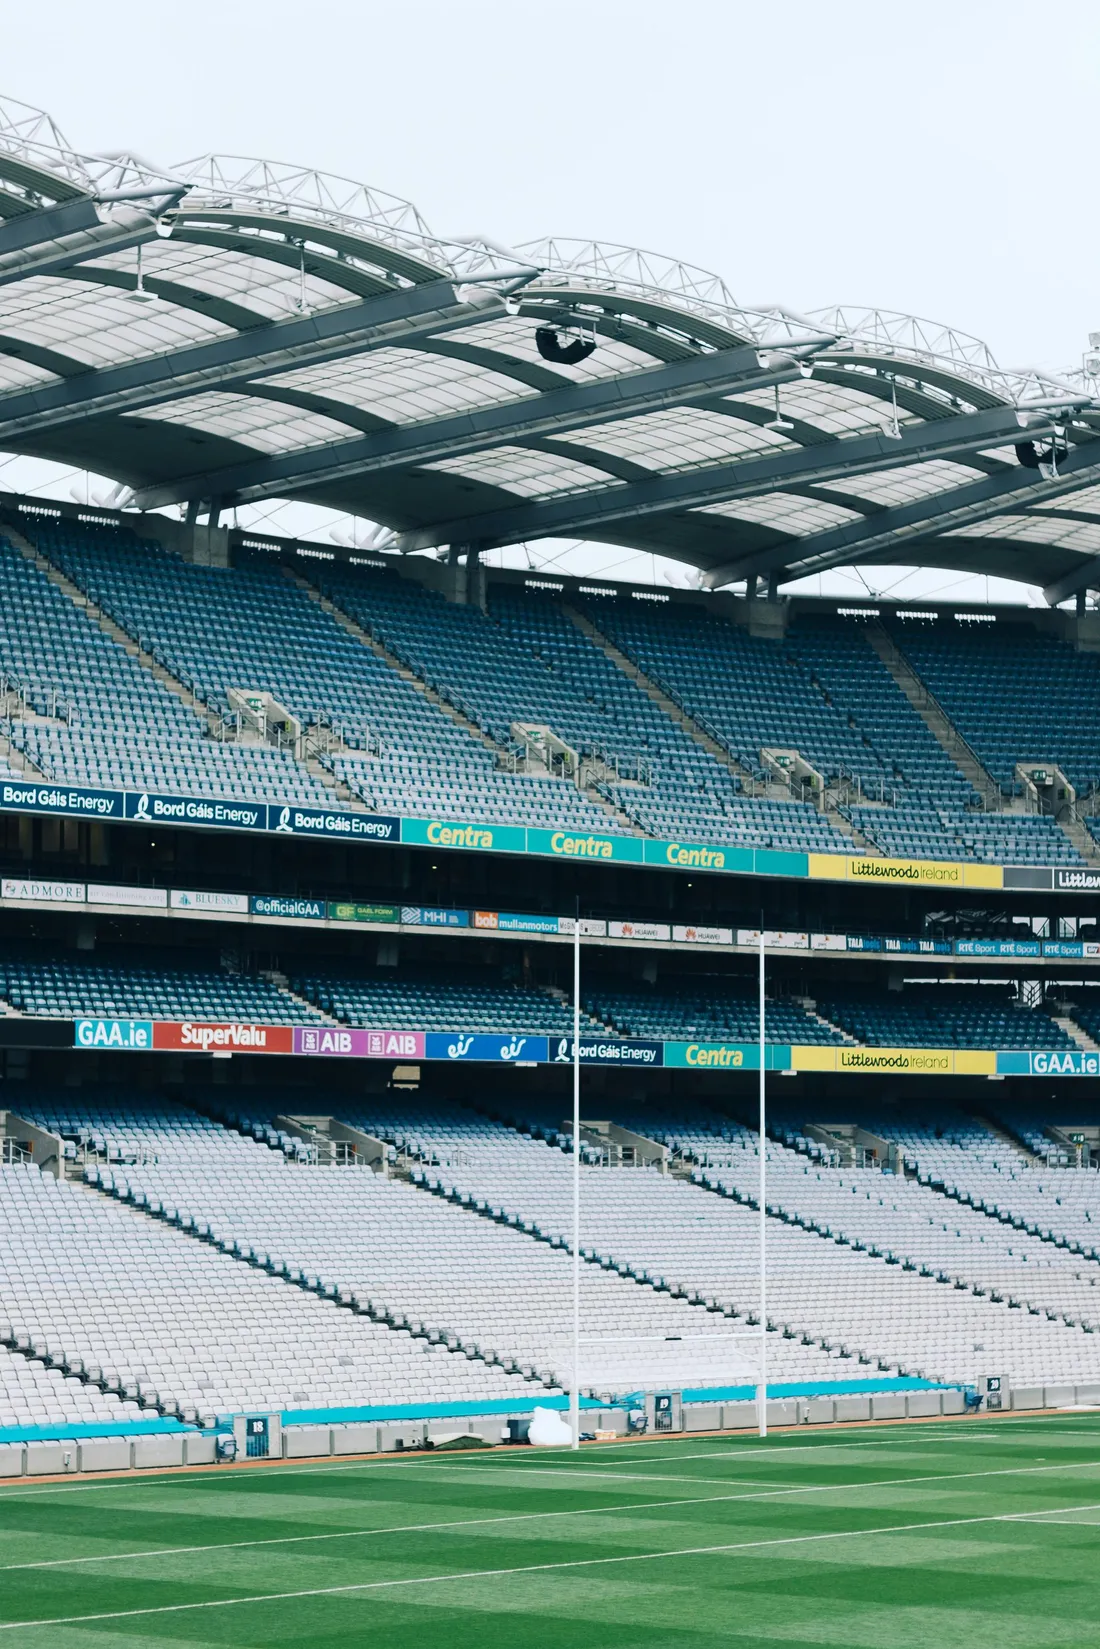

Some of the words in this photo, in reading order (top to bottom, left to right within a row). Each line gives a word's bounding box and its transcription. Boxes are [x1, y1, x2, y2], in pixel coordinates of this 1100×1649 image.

[4, 786, 36, 804] Bord
[38, 789, 67, 807] Gáis
[68, 793, 114, 813] Energy
[154, 800, 185, 816] Bord
[186, 802, 213, 820] Gáis
[215, 805, 258, 825] Energy
[295, 813, 324, 829] Bord
[325, 816, 350, 831] Gáis
[352, 819, 392, 838] Energy
[427, 822, 493, 848] Centra
[551, 832, 613, 858] Centra
[666, 843, 725, 868] Centra
[21, 884, 82, 898] ADMORE
[195, 893, 240, 906] BLUESKY
[255, 900, 320, 916] @officialGAA
[336, 905, 354, 917] GF
[424, 911, 446, 923] MHI
[475, 913, 497, 928] bob
[499, 919, 558, 932] mullanmotors
[635, 928, 658, 936] HUAWEI
[848, 937, 863, 949] TALA
[885, 939, 900, 950] TALA
[919, 940, 934, 951] TALA
[975, 944, 996, 956] Sport
[1016, 944, 1037, 955] Sport
[1061, 945, 1081, 955] Sport
[78, 1021, 147, 1046] GAA.ie
[181, 1023, 266, 1050] SuperValu
[320, 1032, 352, 1053] AIB
[386, 1035, 416, 1055] AIB
[598, 1044, 620, 1059] Gáis
[621, 1046, 656, 1062] Energy
[685, 1044, 743, 1067] Centra
[1033, 1053, 1098, 1074] GAA.ie
[990, 1379, 999, 1390] 20
[252, 1420, 264, 1433] 18
